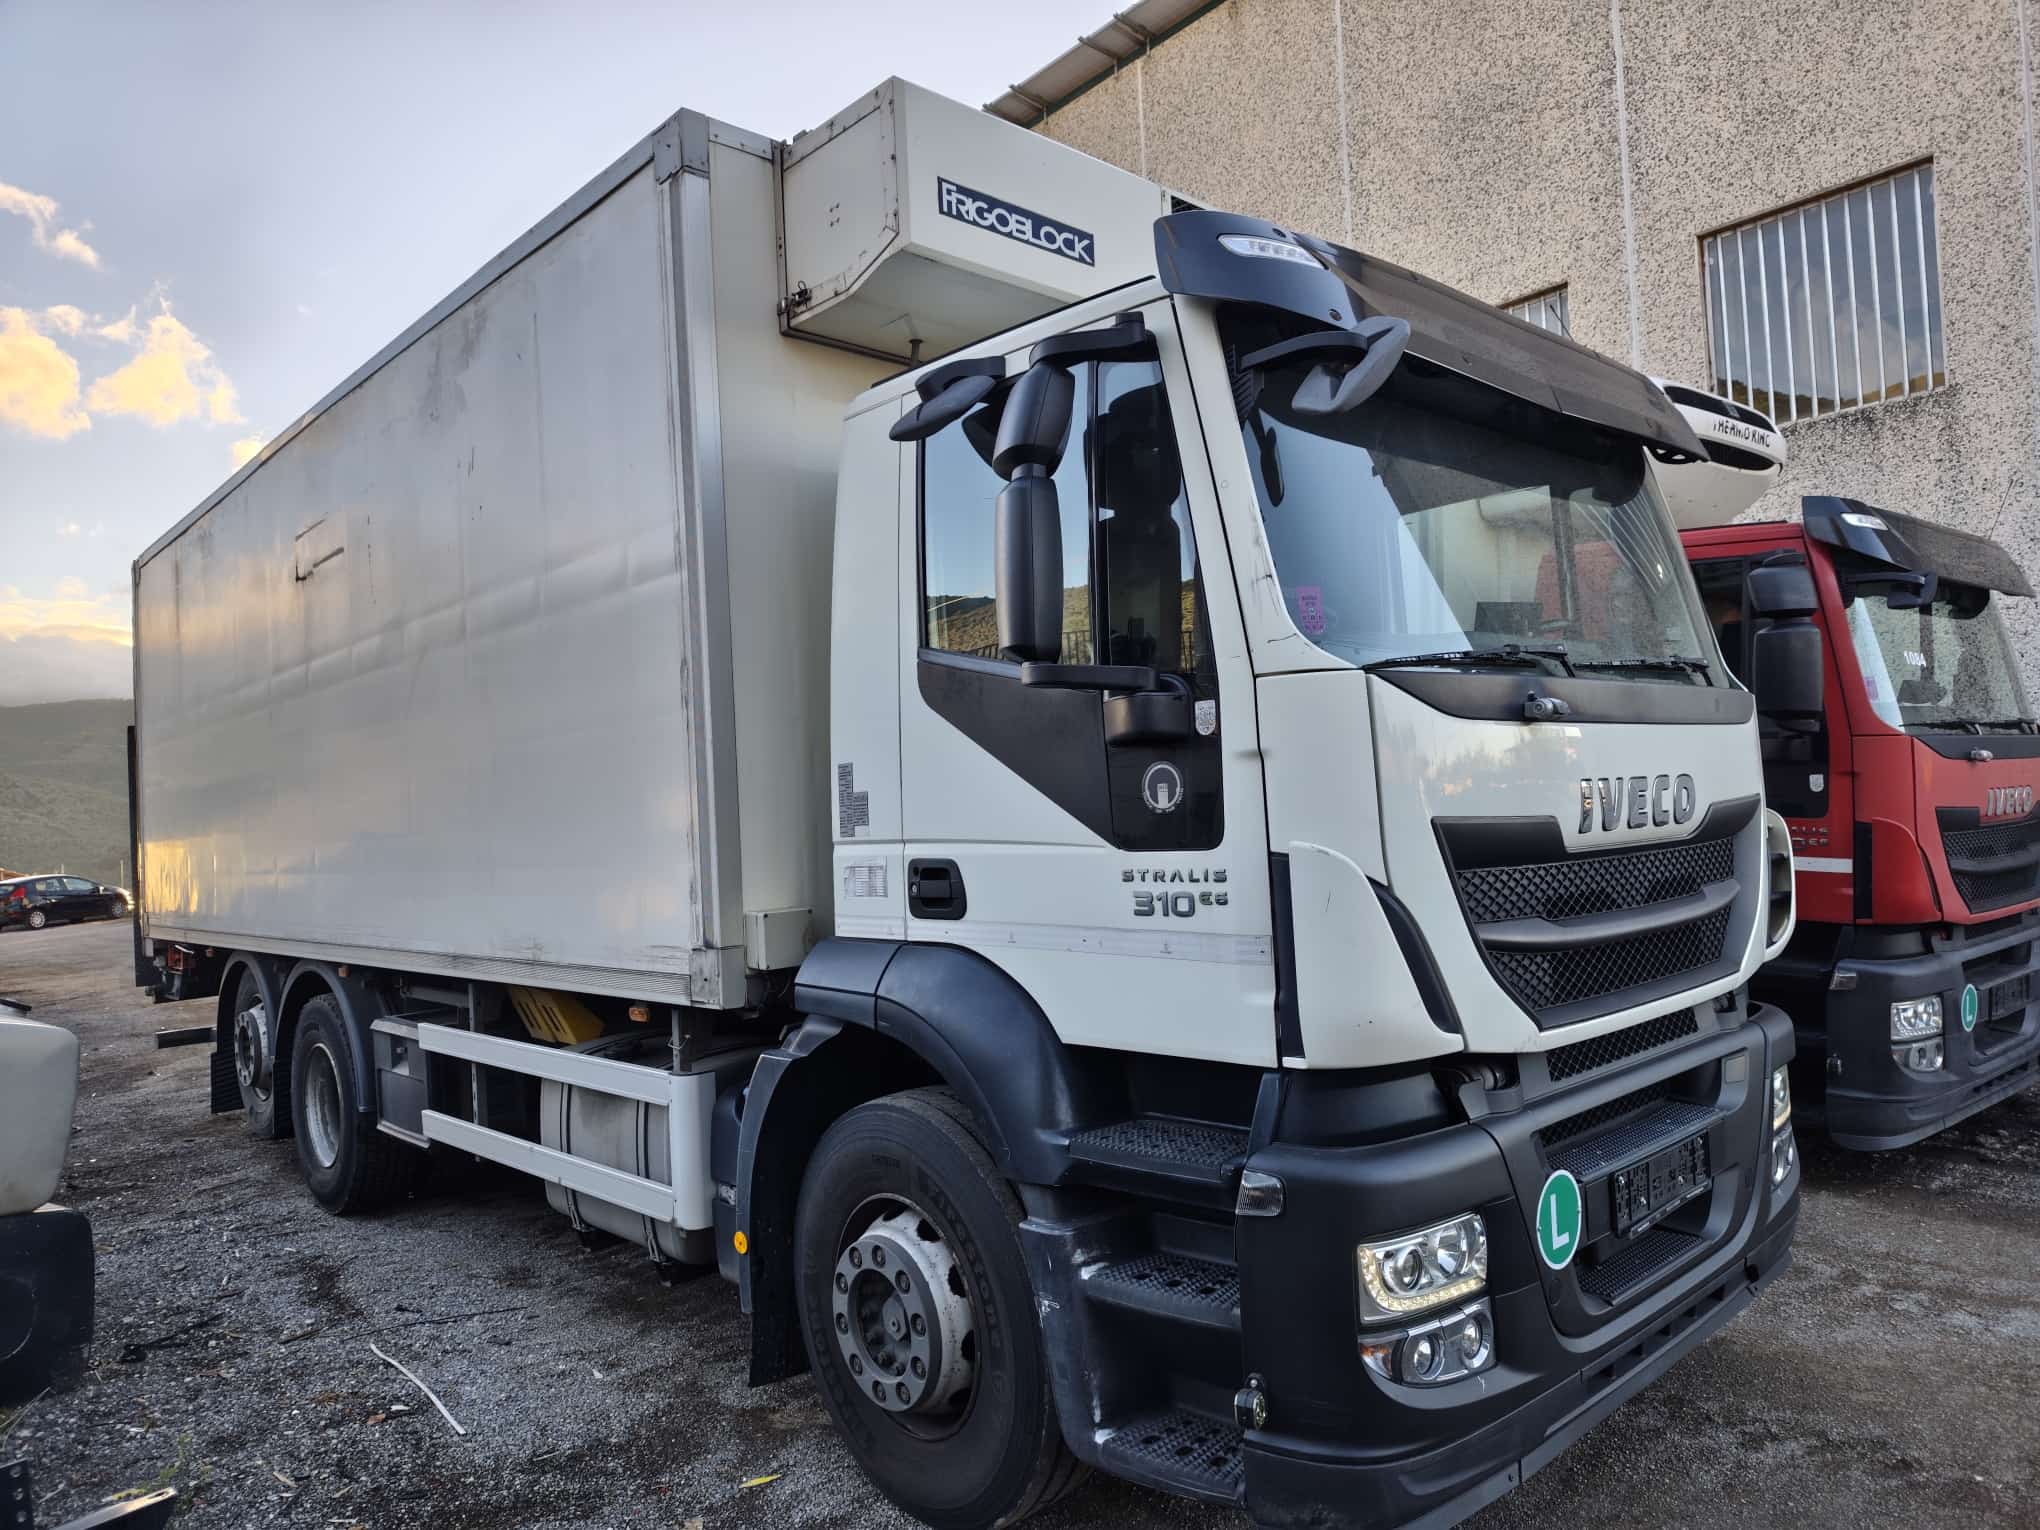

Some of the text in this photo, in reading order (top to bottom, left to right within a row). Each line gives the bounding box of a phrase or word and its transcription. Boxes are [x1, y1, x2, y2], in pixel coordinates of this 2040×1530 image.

[941, 181, 1093, 264] FRIGOBLOCK
[1578, 773, 1696, 834] IVECO
[1986, 784, 2032, 817] IVECO
[1121, 867, 1228, 883] STRALIS
[1550, 1193, 1570, 1250] L
